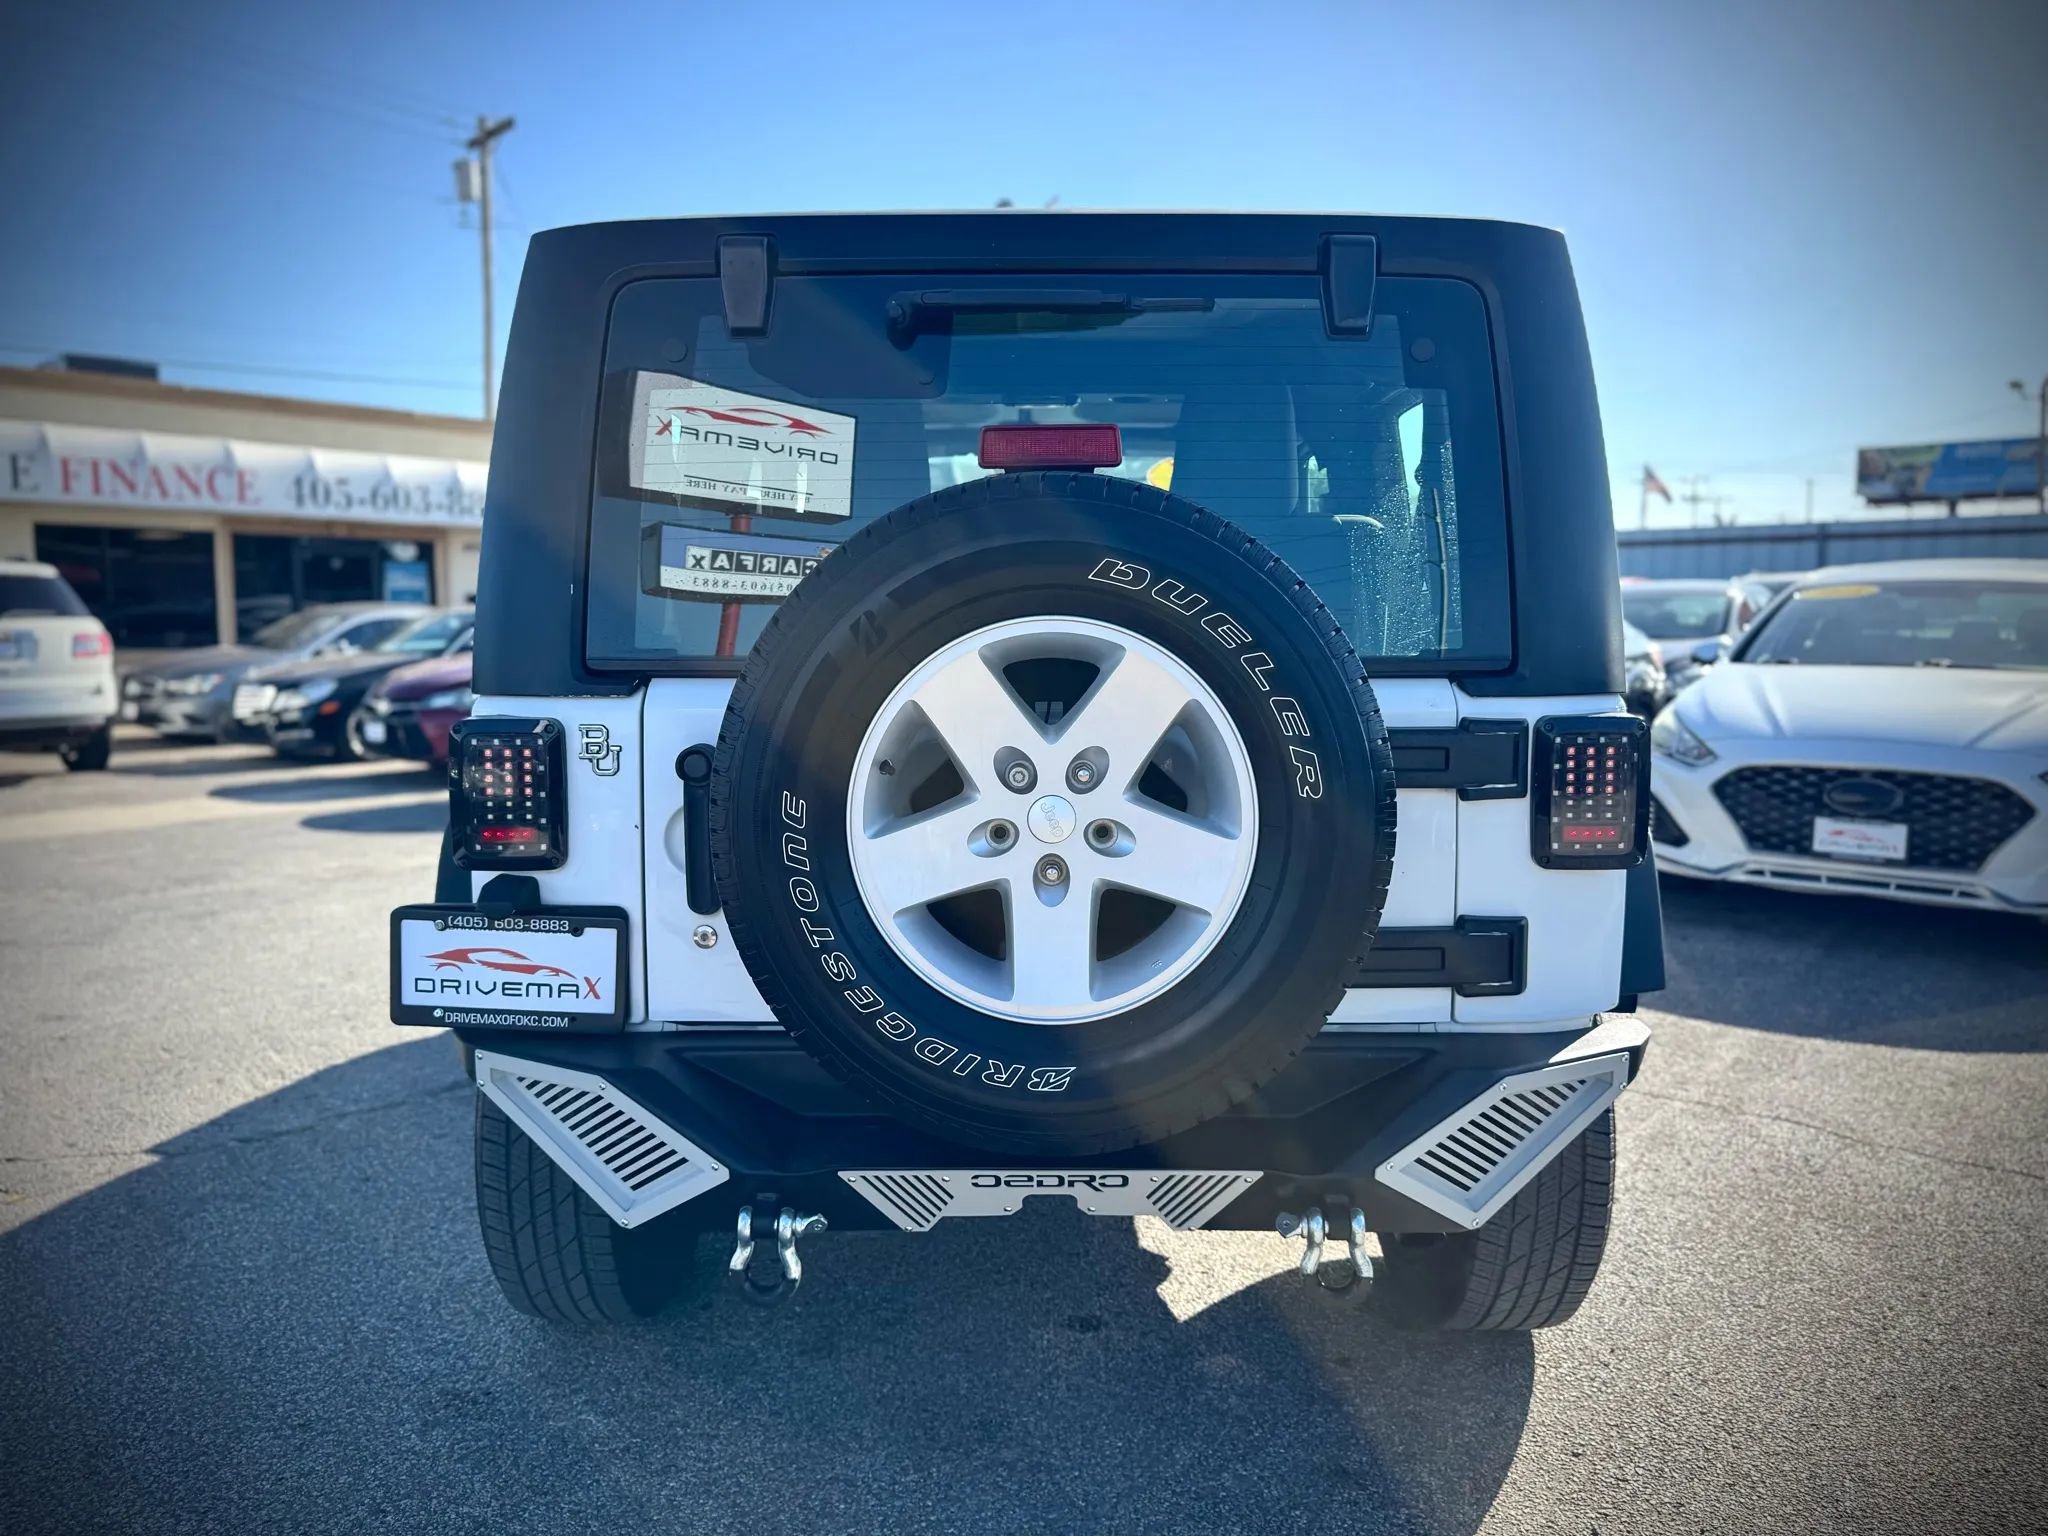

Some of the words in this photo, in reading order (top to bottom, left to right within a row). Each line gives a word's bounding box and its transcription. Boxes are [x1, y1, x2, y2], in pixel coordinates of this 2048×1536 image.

[60, 457, 260, 505] FINANCE
[1088, 558, 1323, 799] DUELER
[578, 723, 622, 776] BU
[1041, 802, 1065, 838] Jeep
[448, 915, 488, 928] (405)
[494, 918, 569, 931] 603-8883
[782, 791, 1076, 1091] BRIDGESTONE
[414, 976, 602, 1000] DRIVEMAX
[445, 1011, 569, 1028] DRIVEMAXOFOKC.COM
